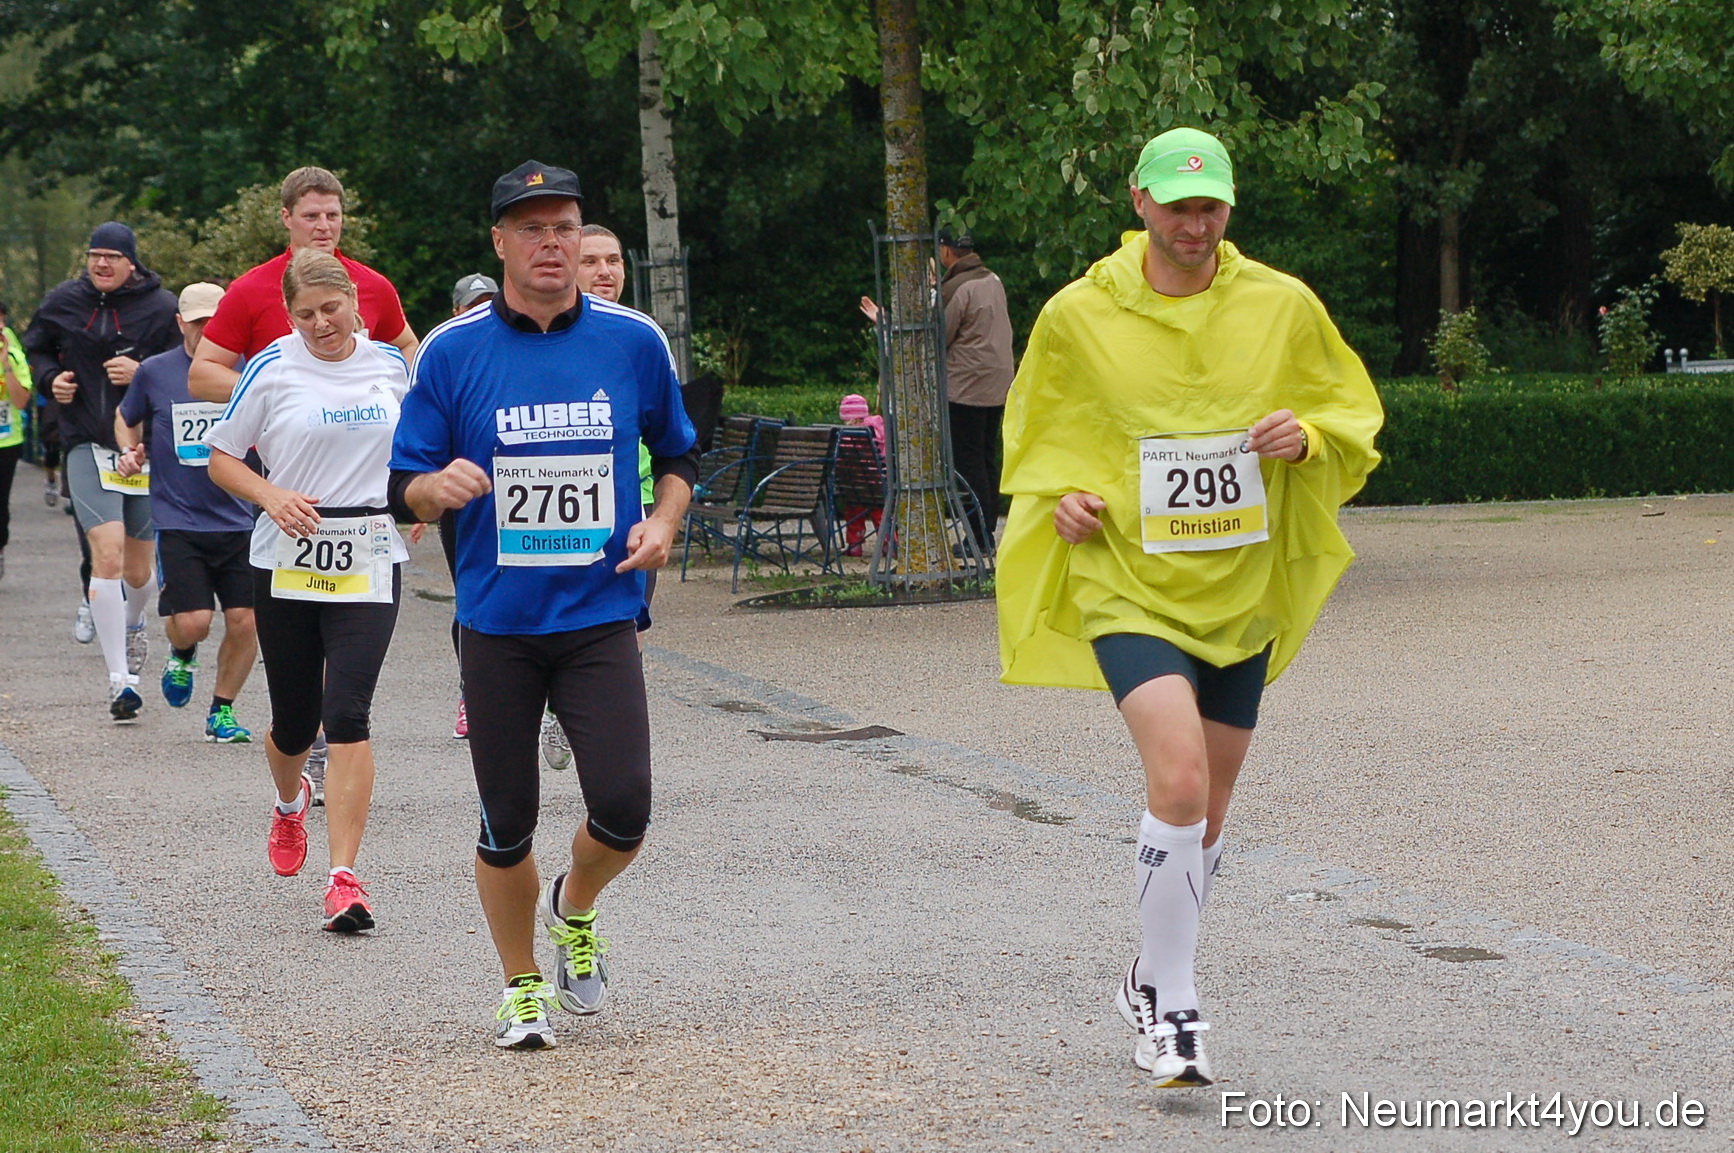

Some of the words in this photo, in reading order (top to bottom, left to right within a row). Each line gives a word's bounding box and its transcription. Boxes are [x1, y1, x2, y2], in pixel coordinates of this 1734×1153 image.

[322, 404, 387, 424] heinloth
[496, 402, 613, 432] HUBER
[523, 428, 609, 440] TECHNOLOGY
[1142, 450, 1183, 462] PARTL
[1185, 446, 1238, 461] Neumarkt
[496, 468, 535, 478] PARTL
[538, 467, 594, 478] Neumarkt
[1166, 463, 1242, 509] 298
[507, 482, 600, 524] 2761
[1170, 517, 1242, 536] Christian
[521, 535, 591, 551] Christian
[294, 537, 353, 571] 203
[306, 576, 336, 592] Jutta
